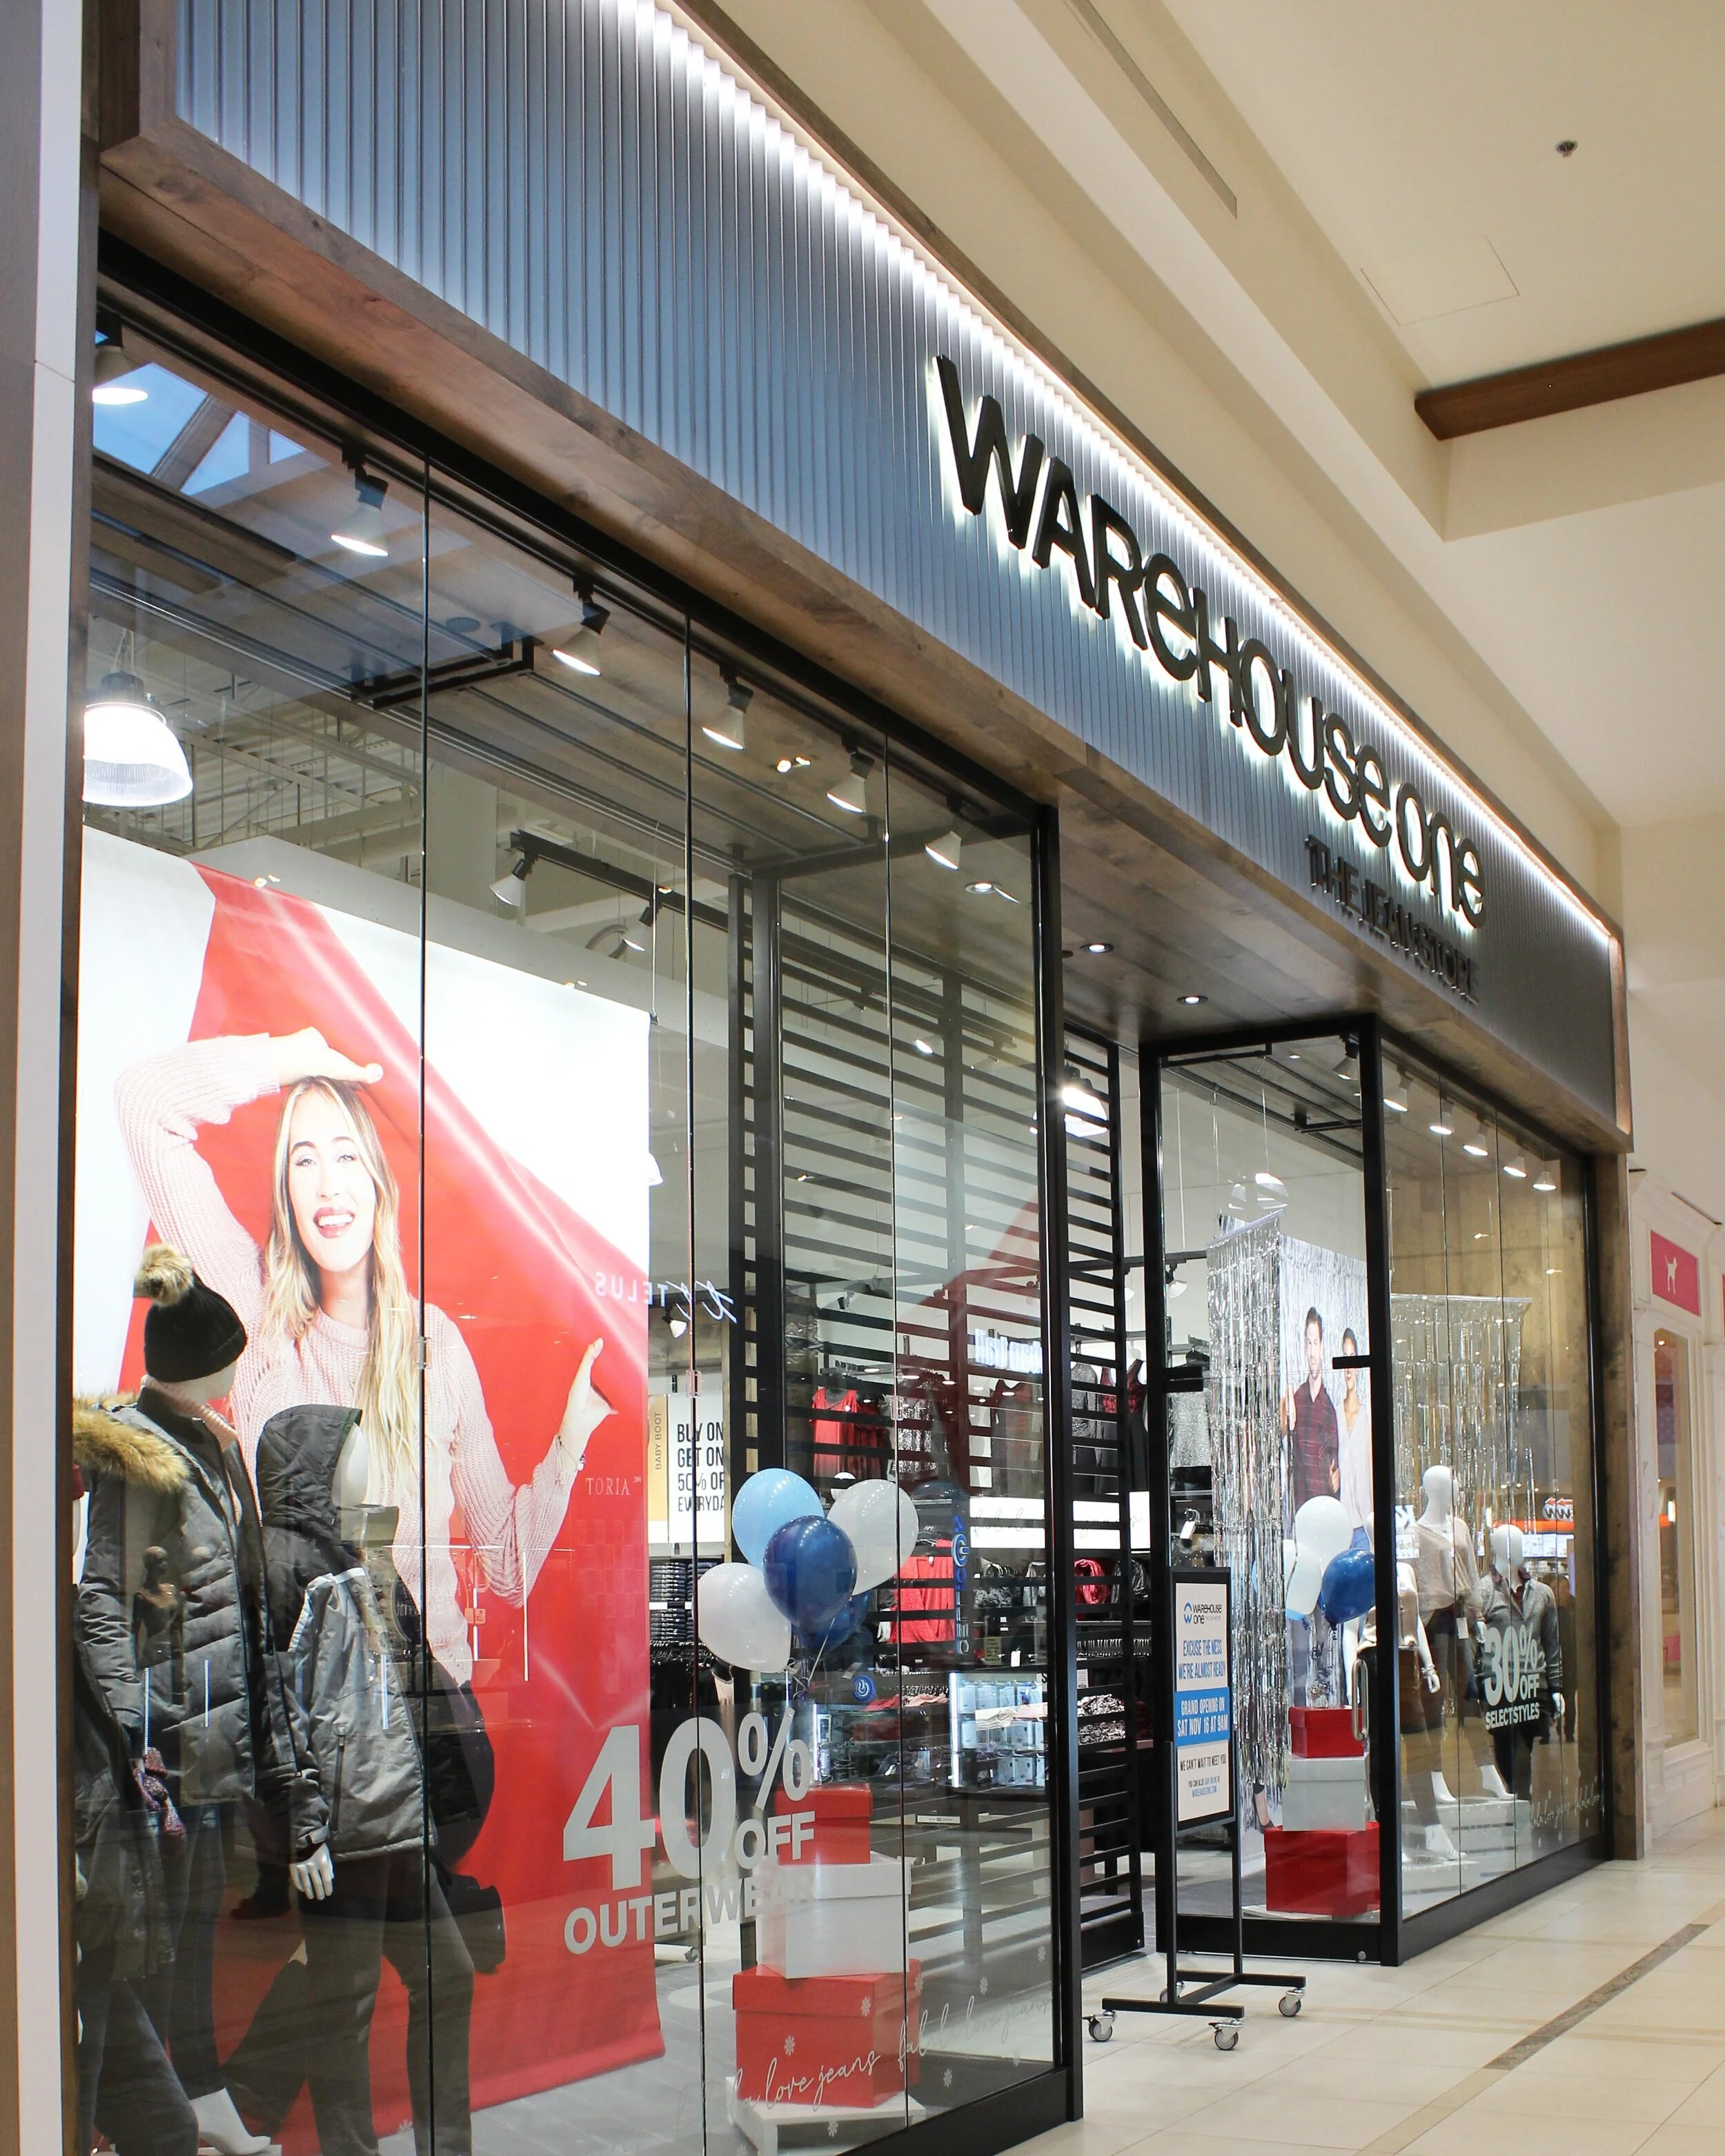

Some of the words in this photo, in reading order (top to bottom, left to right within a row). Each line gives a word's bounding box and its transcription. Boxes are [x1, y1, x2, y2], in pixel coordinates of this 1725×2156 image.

[1304, 834, 1362, 919] THE
[677, 1422, 702, 1443] BUY
[678, 1447, 702, 1467] GET
[585, 1477, 631, 1496] TORIA
[1183, 1640, 1201, 1656] EXCUSE
[1203, 1639, 1211, 1656] THE
[1212, 1639, 1222, 1655] MESS
[1179, 1663, 1194, 1679] WE'RE
[1195, 1661, 1212, 1679] ALMOST
[1213, 1661, 1225, 1677] READY
[1484, 1622, 1537, 1706] 30%
[1519, 1673, 1540, 1701] OFF
[1181, 1699, 1199, 1716] GRAND
[1199, 1697, 1219, 1714] OPENING
[1219, 1697, 1225, 1712] ON
[1486, 1707, 1513, 1730] SELECT
[1513, 1702, 1540, 1723] STYLES
[1177, 1719, 1188, 1737] SAT
[1189, 1717, 1202, 1736] NOV
[1203, 1717, 1210, 1734] 16
[1210, 1715, 1216, 1733] AT
[1217, 1714, 1228, 1732] 9AM
[1180, 1760, 1185, 1771] WE
[1186, 1759, 1196, 1770] CAN'T
[1198, 1757, 1207, 1768] WAIT
[563, 1705, 811, 1891] 40%
[734, 1810, 816, 1870] OFF
[563, 1871, 816, 1955] OUTERWEAR
[765, 2057, 815, 2110] love
[812, 2050, 882, 2113] jeans
